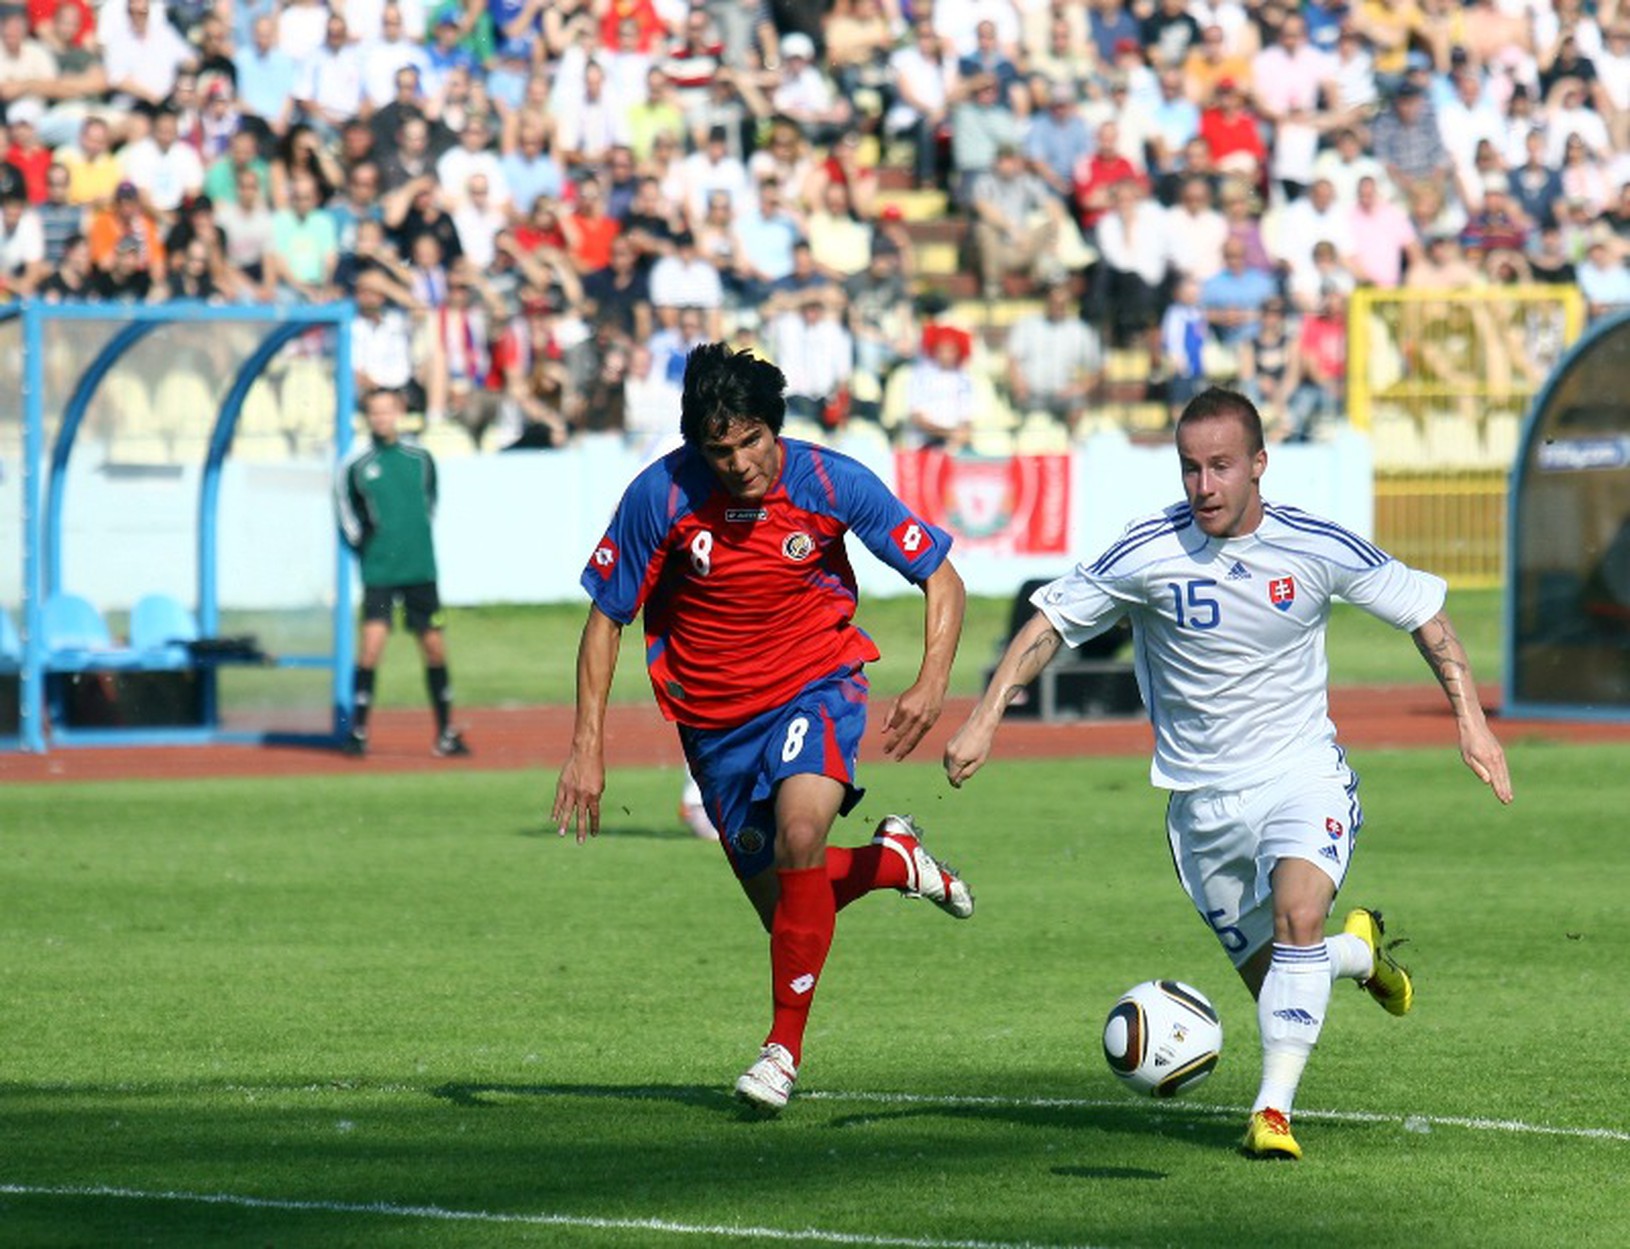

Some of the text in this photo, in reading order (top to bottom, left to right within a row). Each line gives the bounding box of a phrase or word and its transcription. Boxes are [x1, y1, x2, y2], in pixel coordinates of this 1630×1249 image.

[691, 530, 713, 577] 8
[1168, 579, 1221, 630] 15
[781, 717, 809, 763] 8
